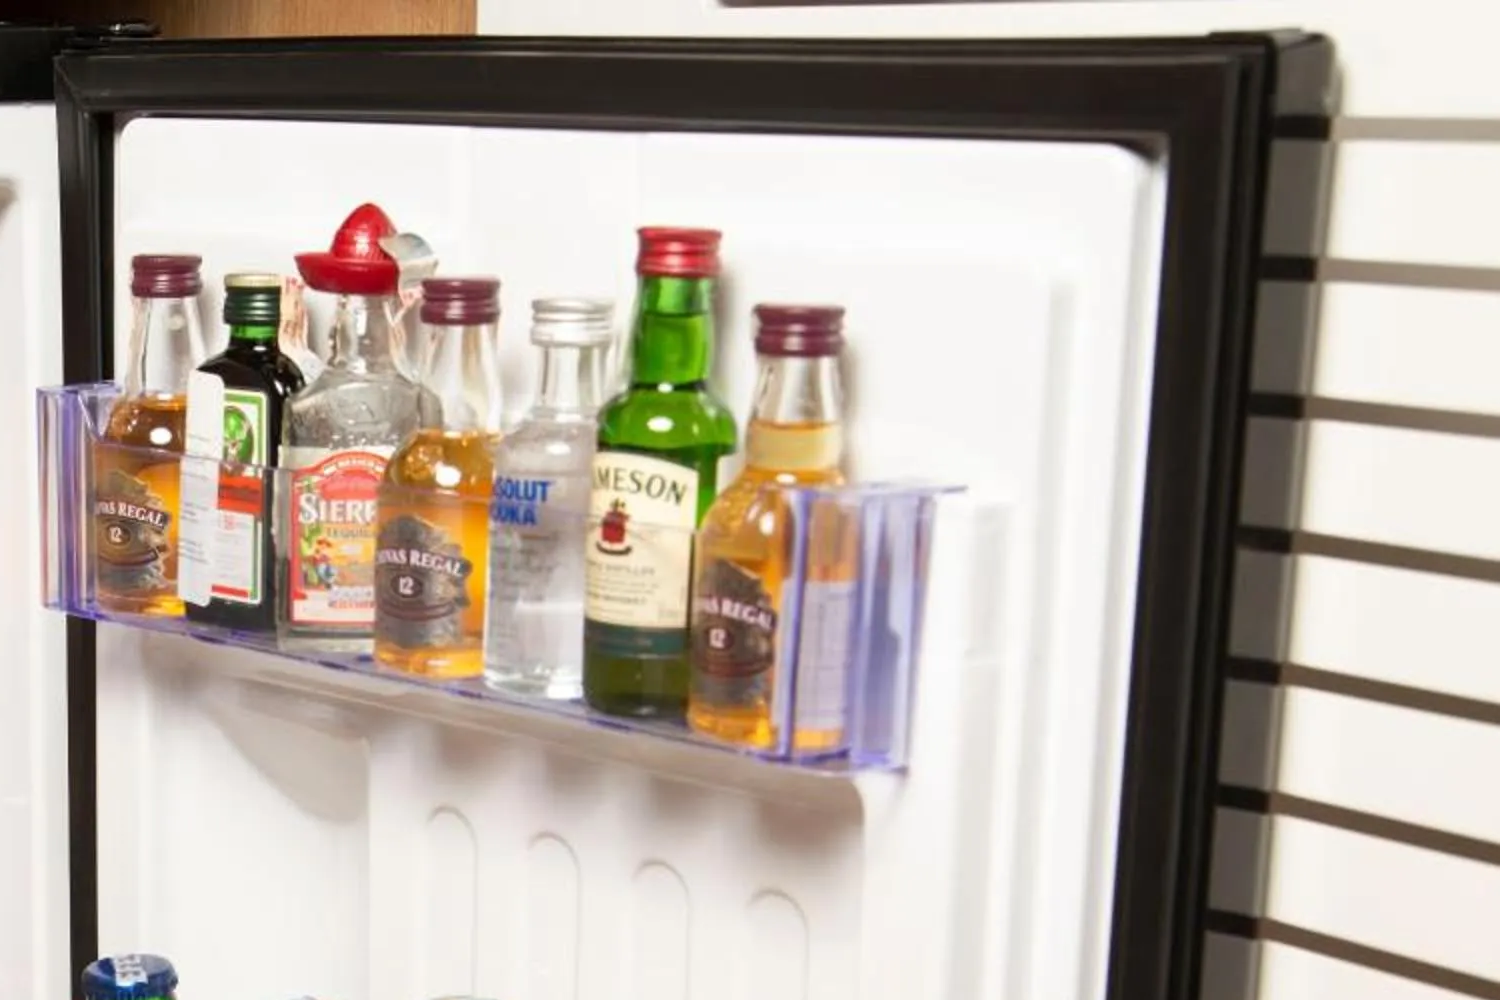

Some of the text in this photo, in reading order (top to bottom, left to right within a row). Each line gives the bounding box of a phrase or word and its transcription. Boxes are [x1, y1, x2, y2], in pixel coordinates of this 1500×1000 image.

[493, 476, 549, 502] SOLUT
[596, 466, 687, 505] MESON
[118, 502, 164, 528] REGAL
[298, 492, 377, 524] SIERR
[409, 548, 464, 578] REGAL
